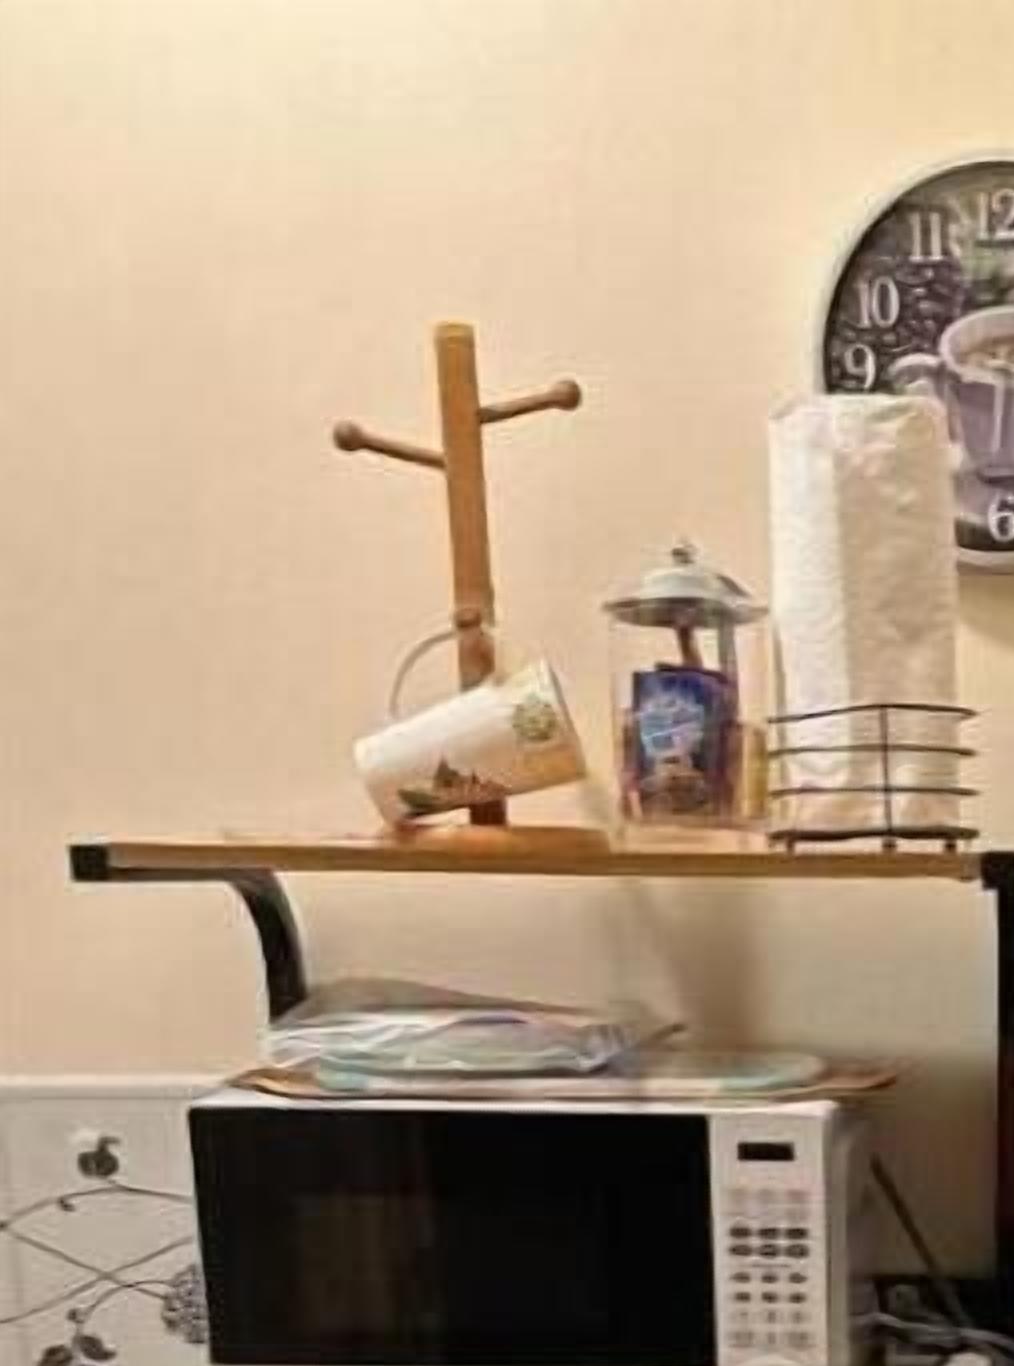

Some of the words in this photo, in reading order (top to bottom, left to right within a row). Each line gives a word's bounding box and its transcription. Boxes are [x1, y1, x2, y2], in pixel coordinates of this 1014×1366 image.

[909, 212, 945, 263] 11
[856, 276, 899, 328] 10
[844, 344, 876, 391] 9
